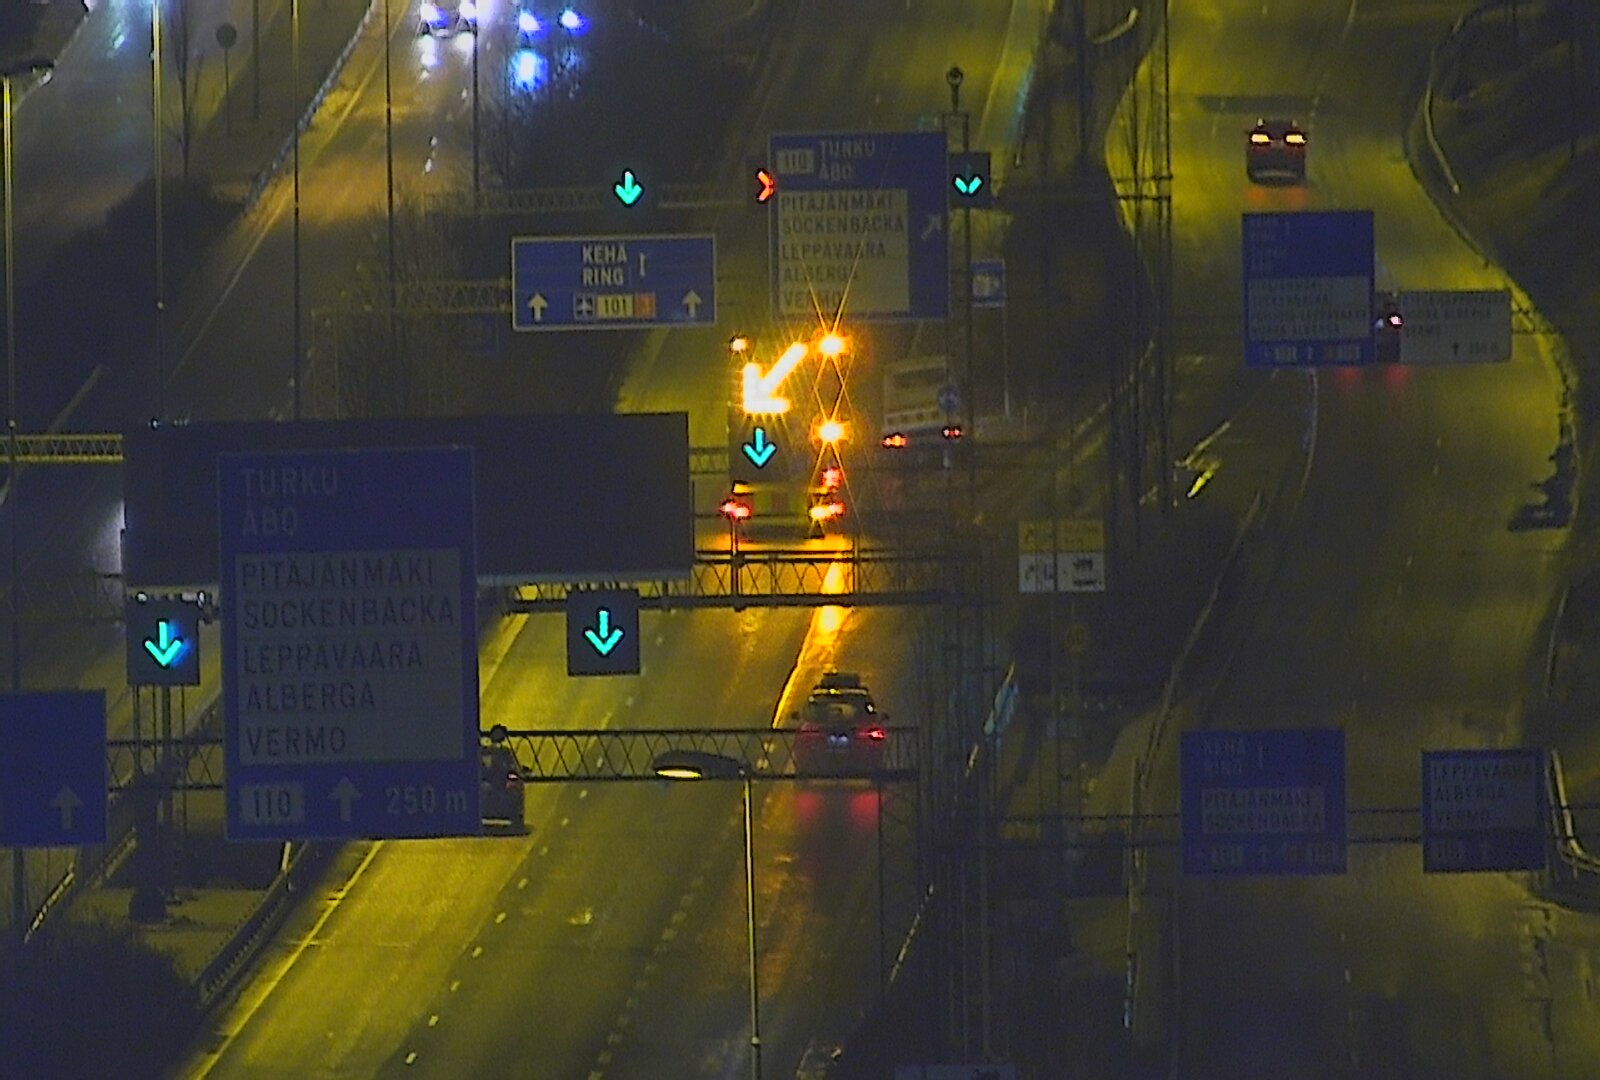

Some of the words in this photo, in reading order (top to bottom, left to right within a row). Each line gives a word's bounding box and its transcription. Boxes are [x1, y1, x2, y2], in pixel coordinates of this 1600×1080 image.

[582, 241, 627, 264] KEHÄ
[583, 267, 624, 286] RING
[603, 297, 627, 315] 101
[241, 466, 337, 497] TURKU
[243, 595, 454, 630] SOCKENBACKA
[246, 679, 376, 712] ALBERGA
[247, 726, 347, 757] VERMO
[253, 790, 291, 818] 110
[385, 784, 436, 816] 250
[446, 790, 467, 814] m
